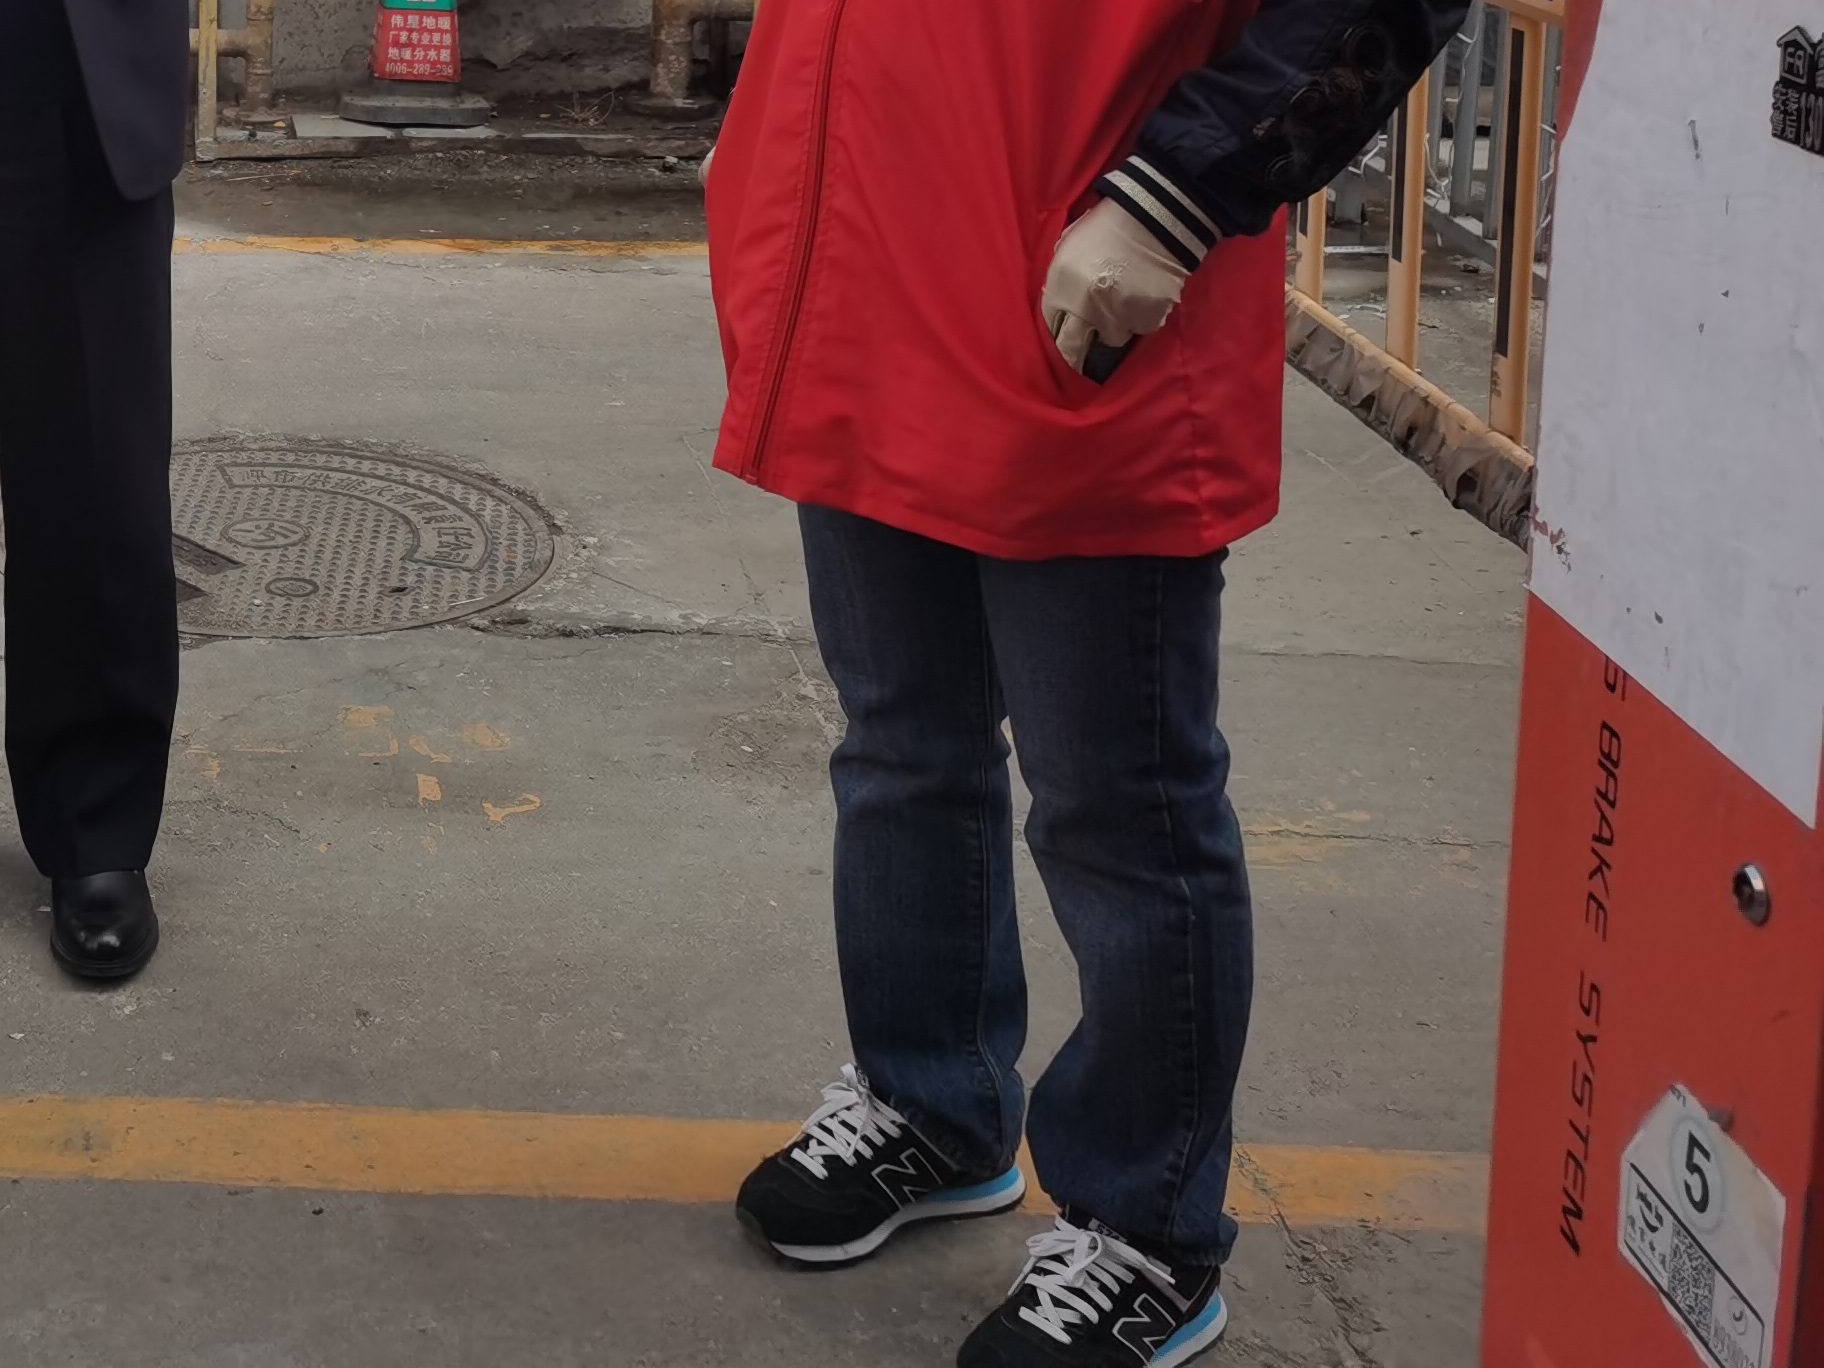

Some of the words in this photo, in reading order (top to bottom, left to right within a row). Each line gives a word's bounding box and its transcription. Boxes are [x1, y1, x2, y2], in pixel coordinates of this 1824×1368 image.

[389, 31, 452, 46] 厂家专业更换
[390, 14, 451, 30] 伟星地暖
[387, 46, 451, 62] 地暖分水器
[1585, 720, 1622, 942] BRAKE
[1559, 969, 1601, 1257] SYSTEM
[1684, 1129, 1712, 1214] 5
